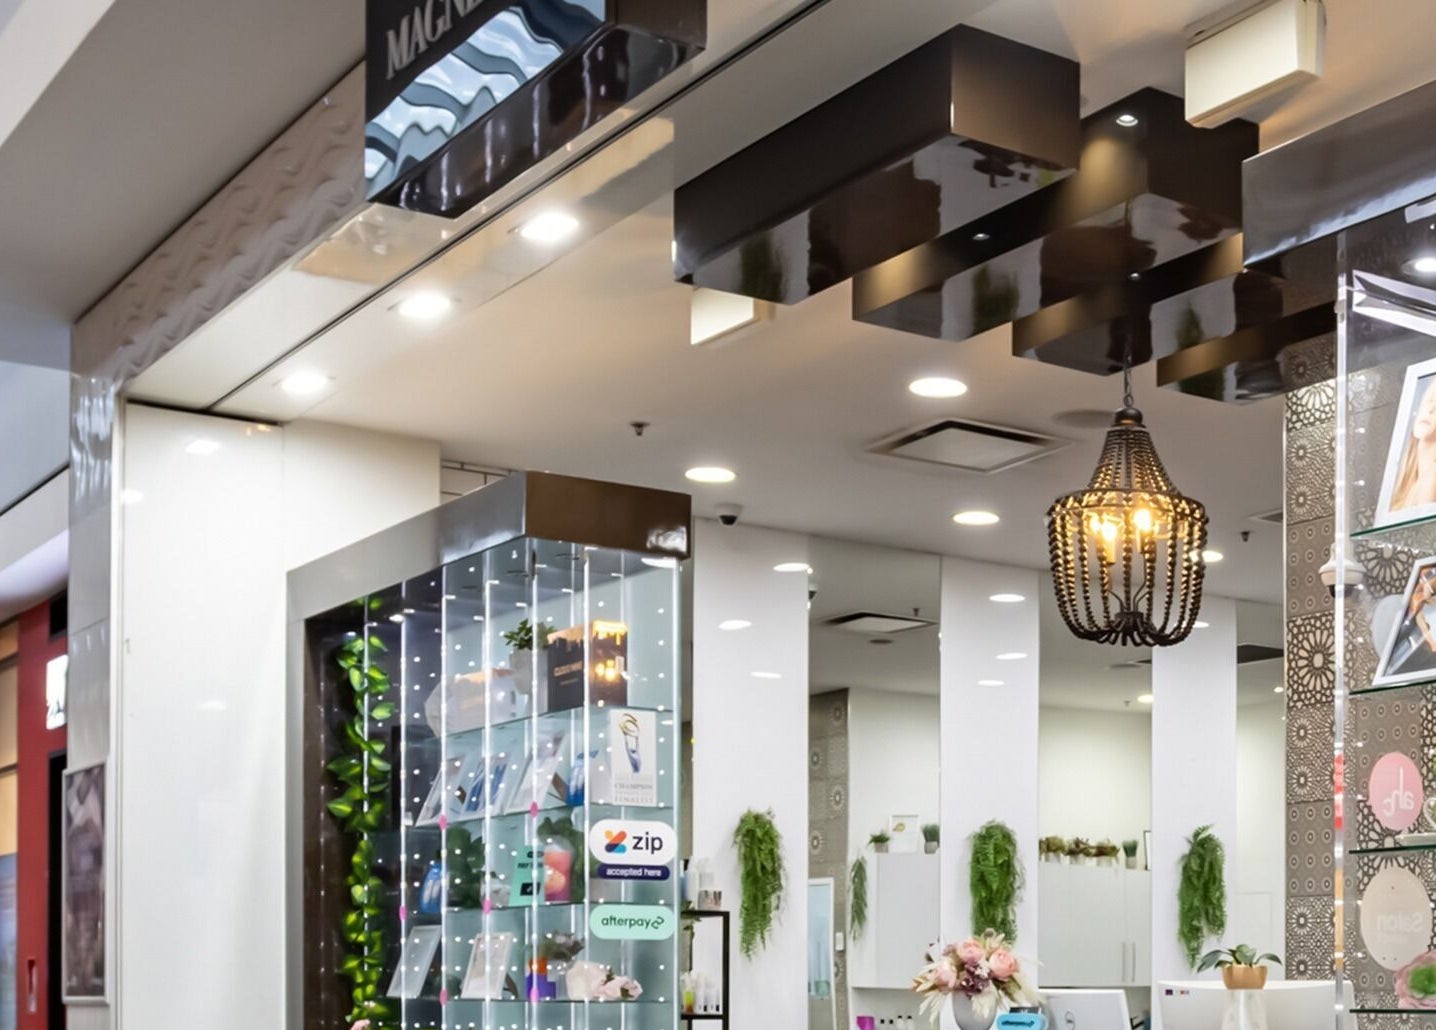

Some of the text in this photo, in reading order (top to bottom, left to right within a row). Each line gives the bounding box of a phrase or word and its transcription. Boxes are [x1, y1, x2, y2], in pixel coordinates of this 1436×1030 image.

[632, 831, 663, 855] zip
[606, 867, 661, 877] accepted here
[601, 915, 651, 930] afterpay
